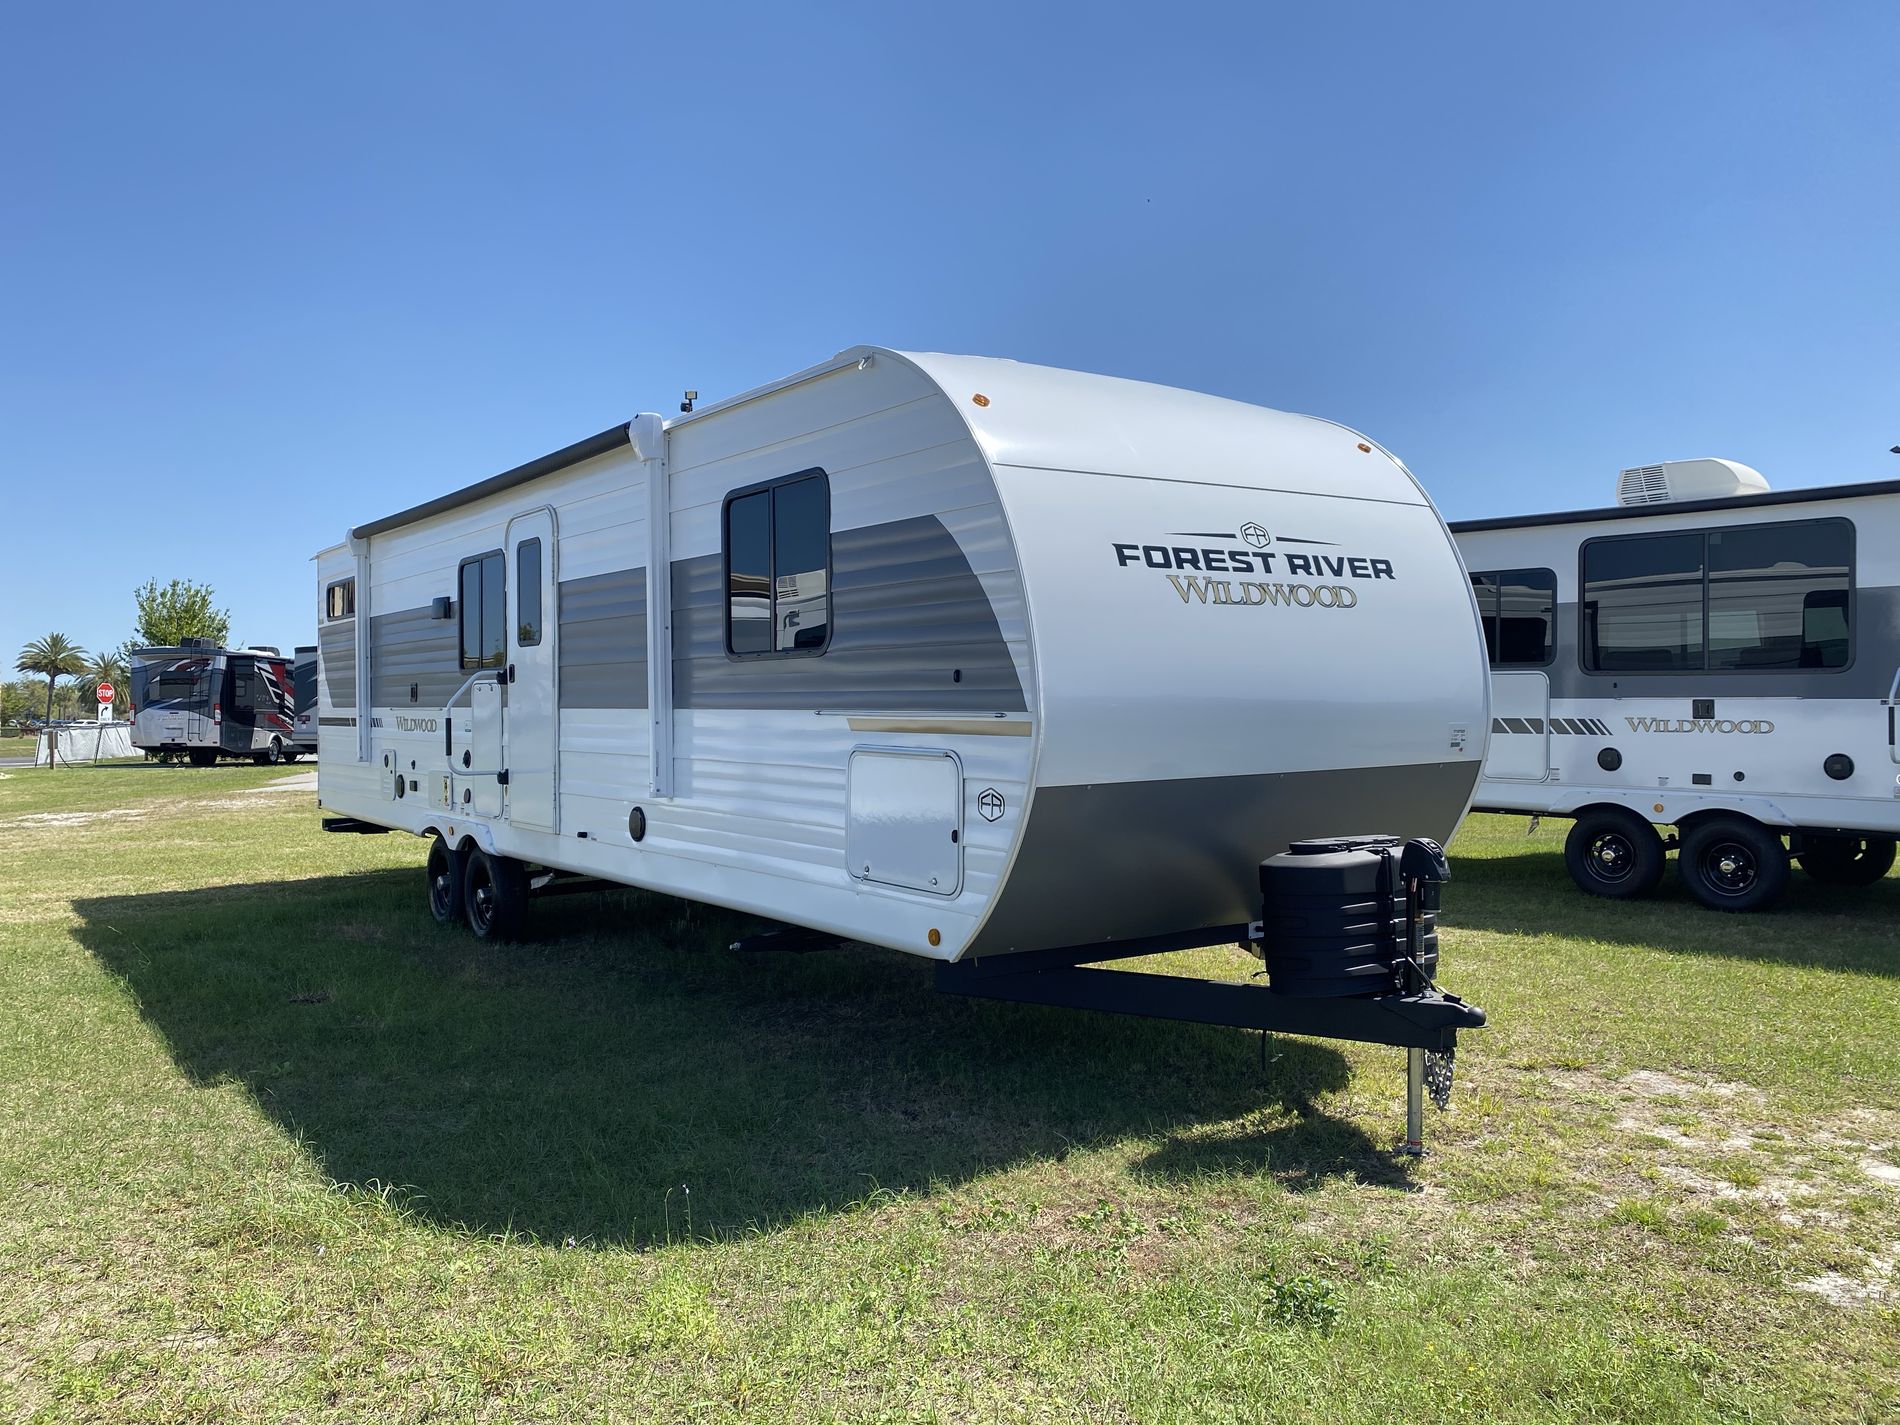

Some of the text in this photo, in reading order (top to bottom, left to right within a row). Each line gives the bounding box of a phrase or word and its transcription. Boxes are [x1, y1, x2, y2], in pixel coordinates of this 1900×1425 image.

[1112, 543, 1396, 580] FOREST RIVER
[1166, 574, 1358, 608] WILDWOOD
[98, 689, 113, 697] STOP
[396, 716, 437, 732] WILDWOOD
[1625, 717, 1775, 734] WILDWOOD
